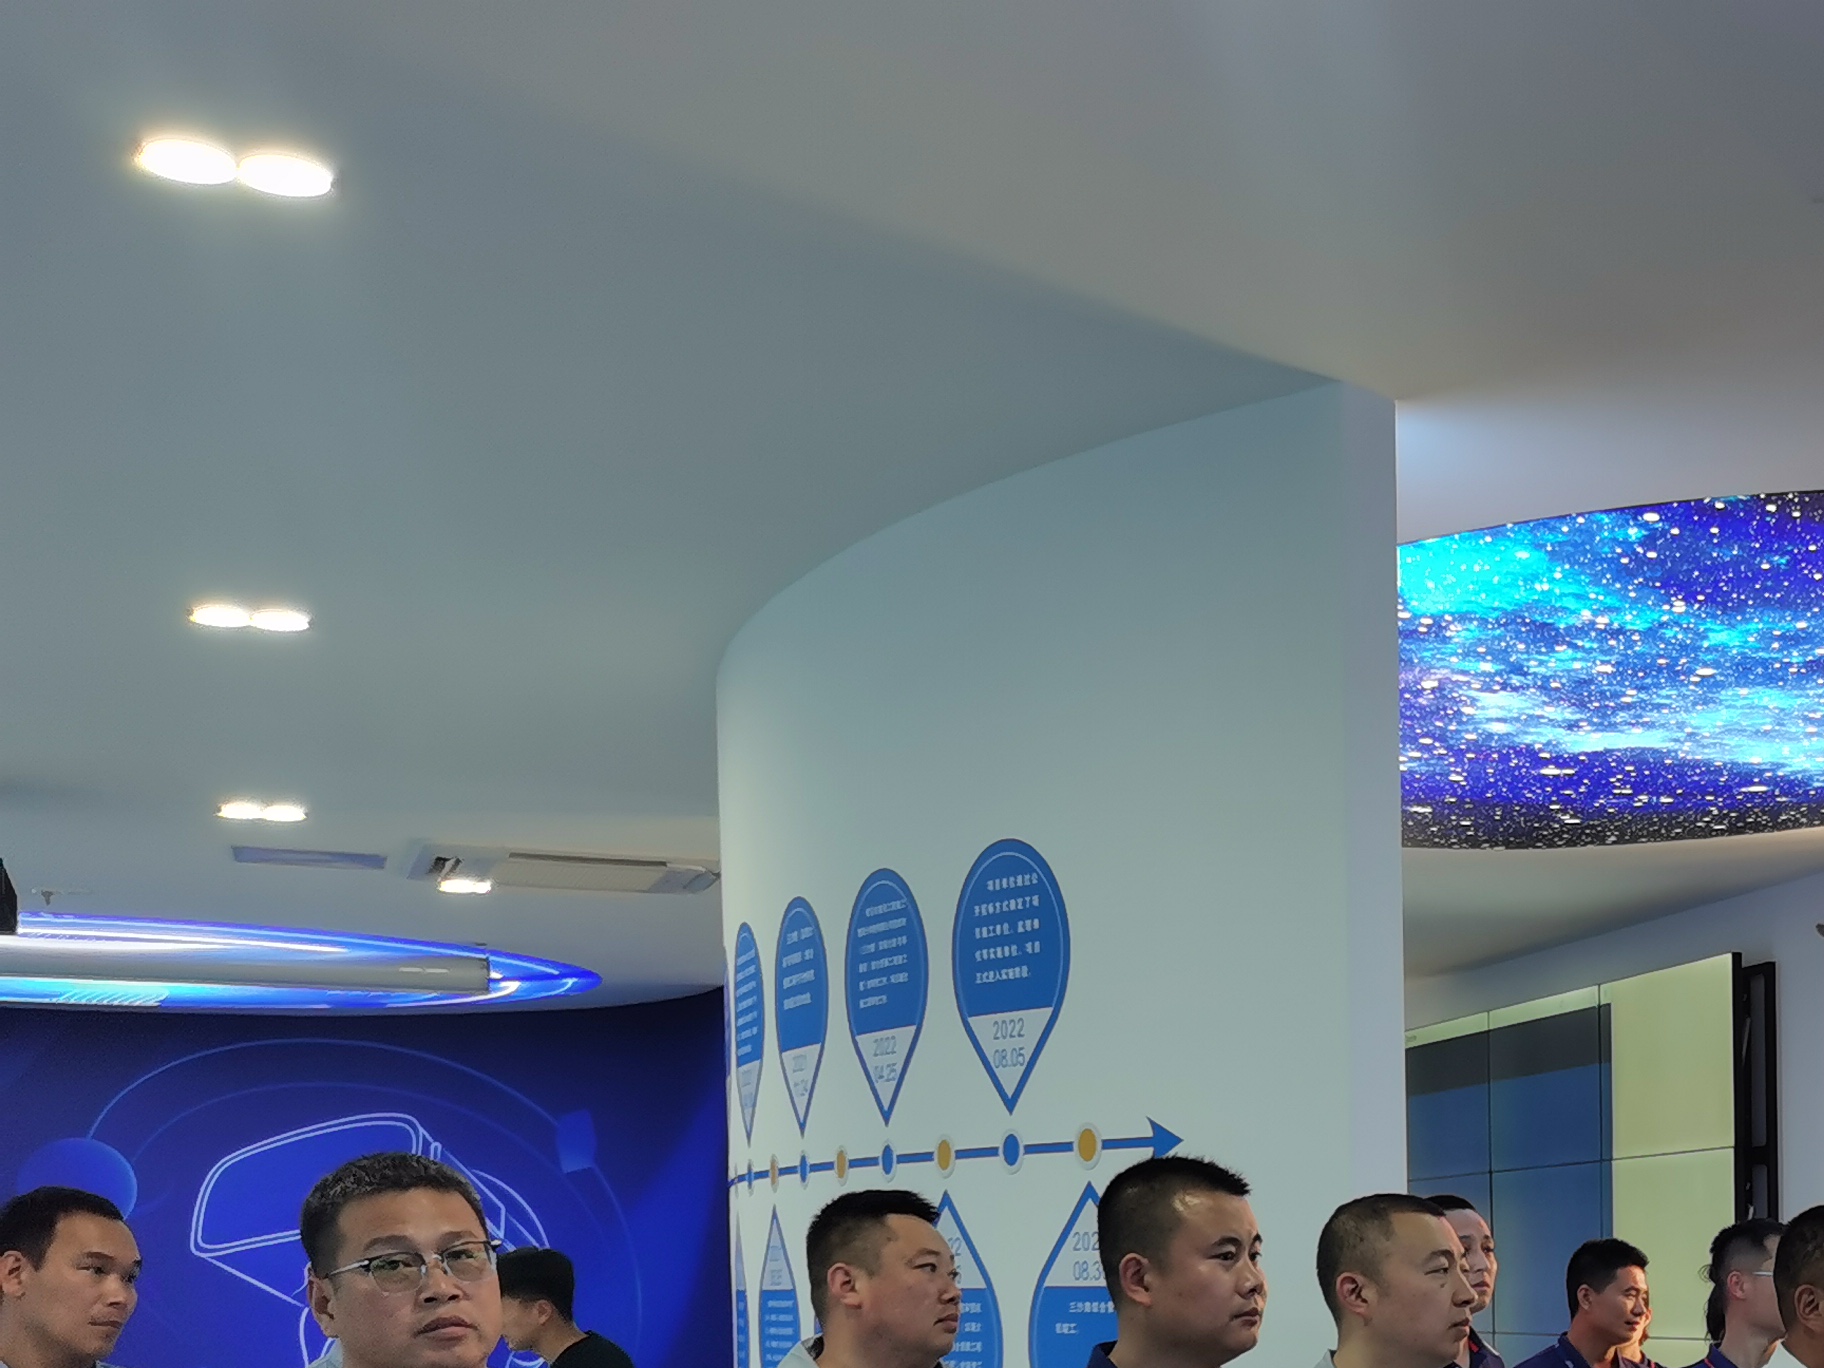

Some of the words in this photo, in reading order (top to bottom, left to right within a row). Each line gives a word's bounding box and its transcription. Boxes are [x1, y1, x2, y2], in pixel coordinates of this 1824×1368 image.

[992, 1018, 1025, 1041] 2022
[1072, 1231, 1101, 1252] 202
[1072, 1260, 1107, 1281] 08.3
